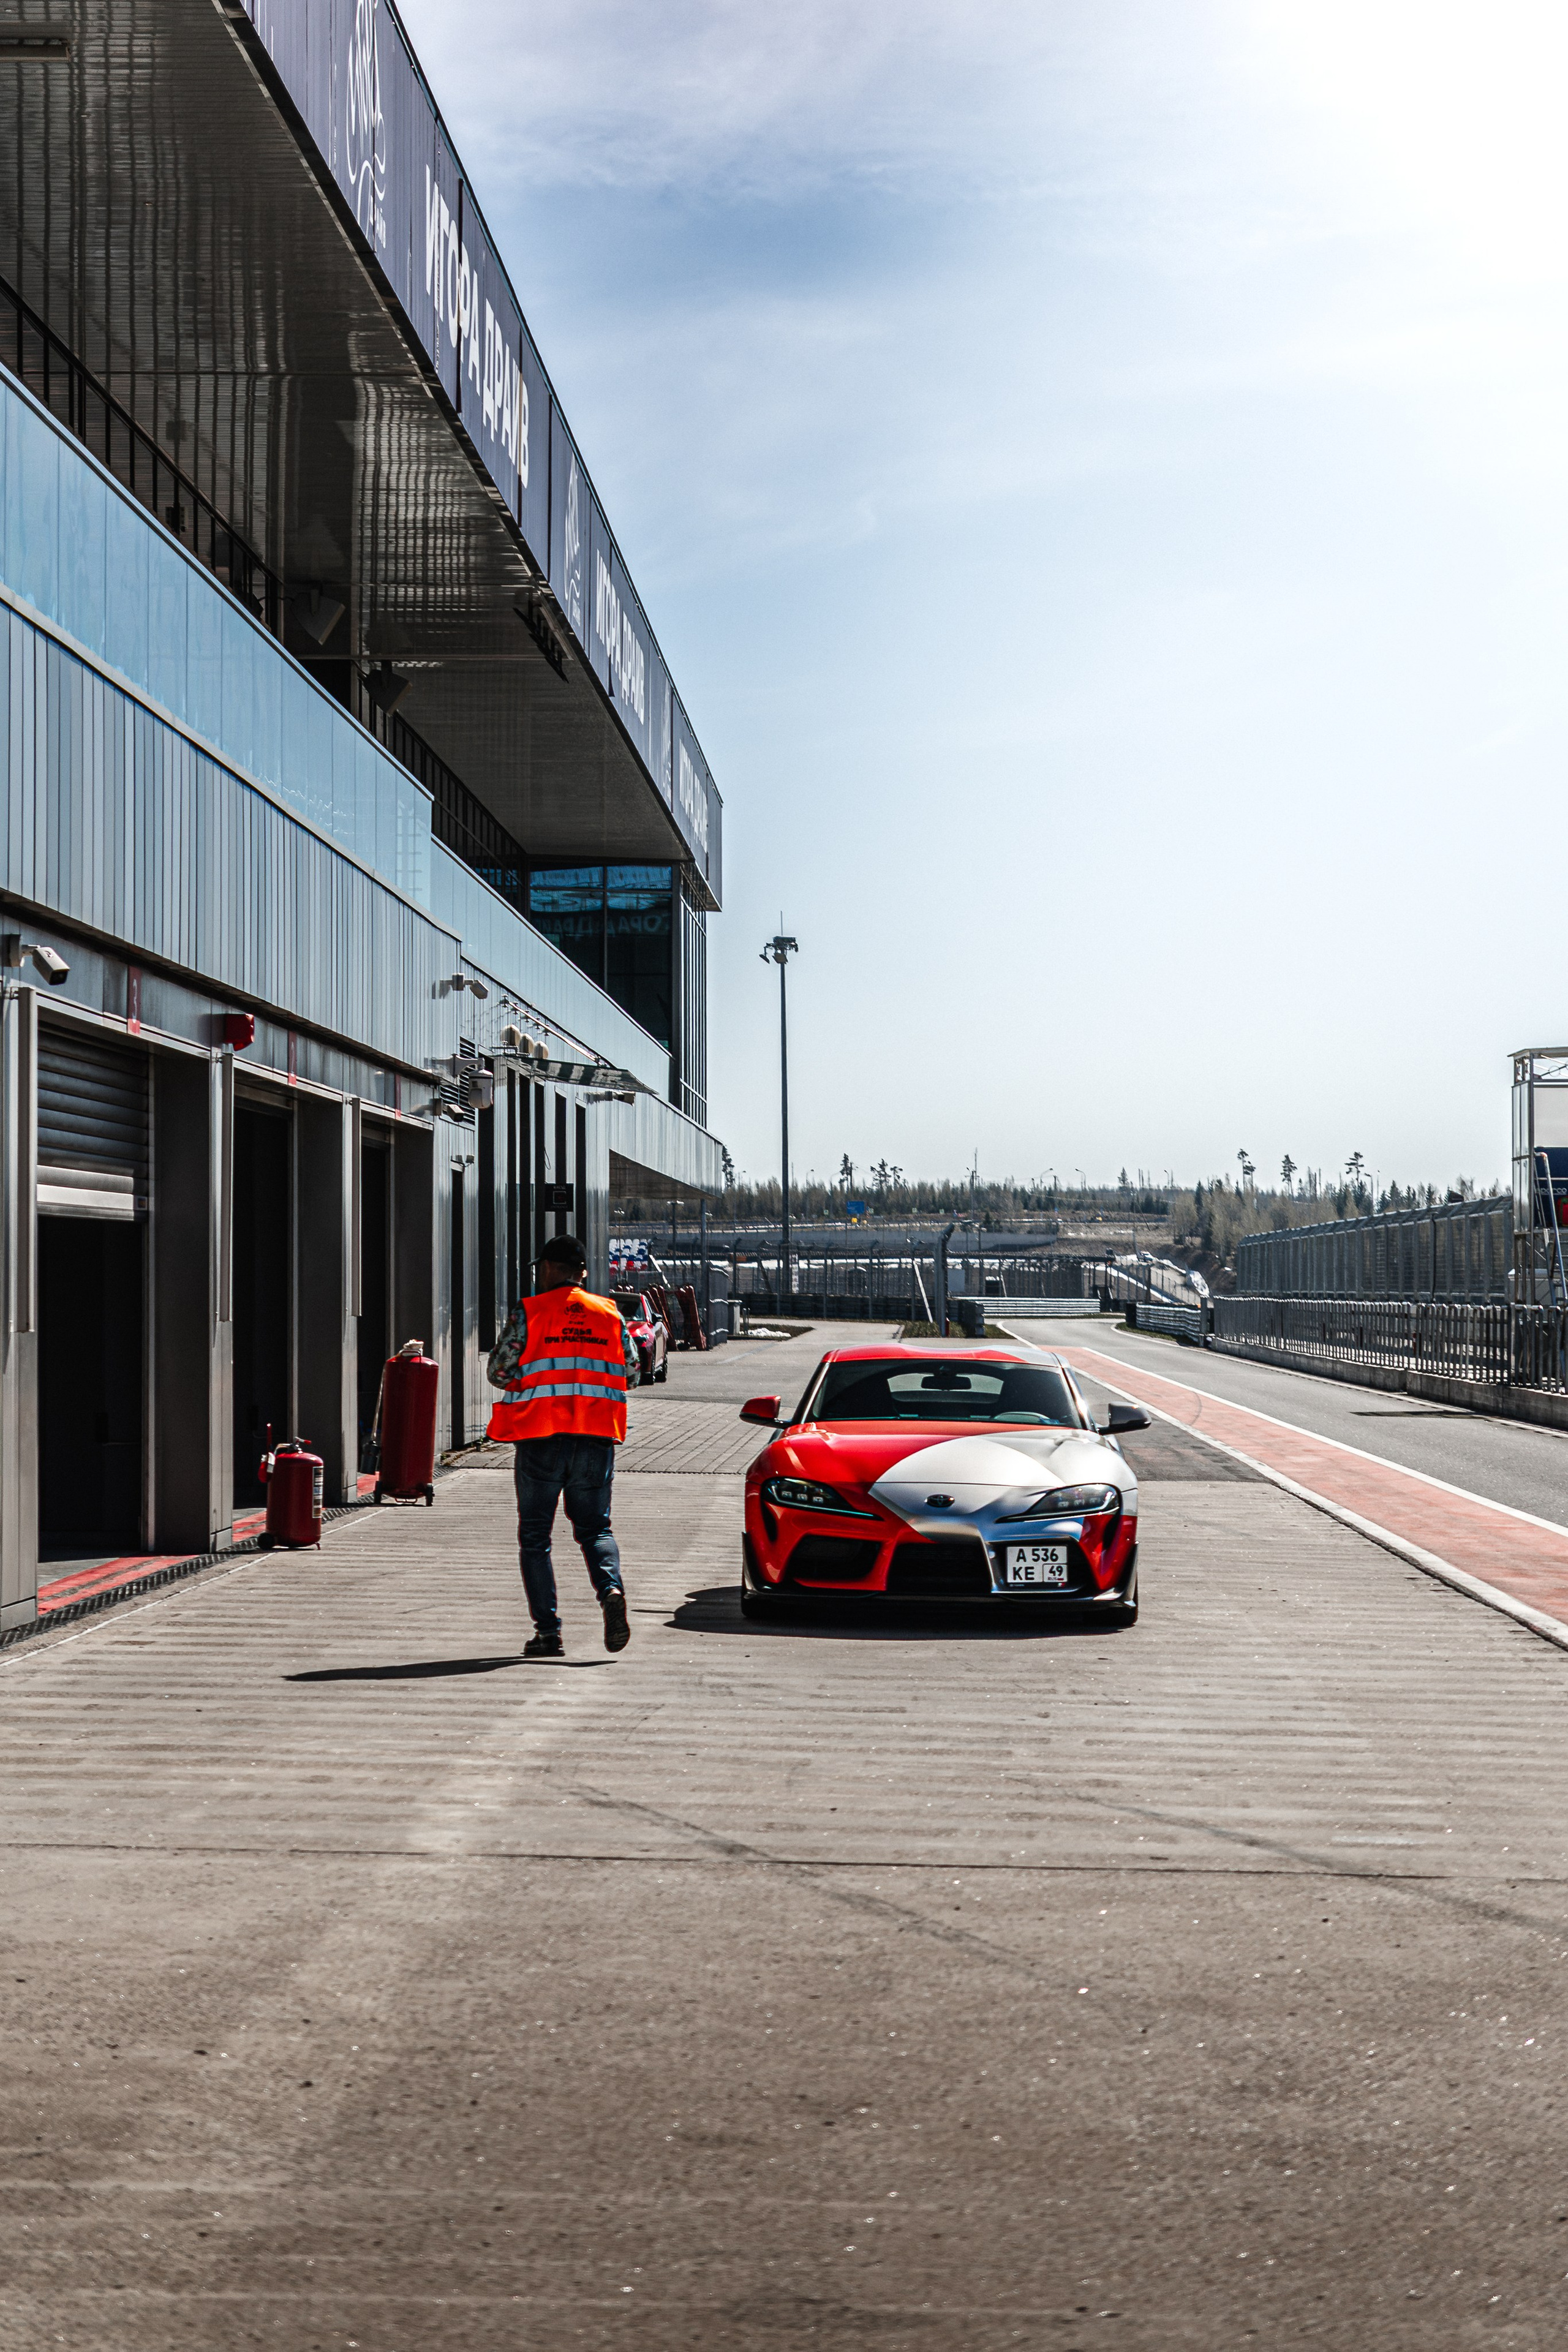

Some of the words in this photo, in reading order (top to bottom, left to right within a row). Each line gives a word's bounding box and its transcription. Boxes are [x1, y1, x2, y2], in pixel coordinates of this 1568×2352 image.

[426, 163, 480, 398] ИГОРА
[596, 548, 621, 681] ИГОРА
[132, 978, 138, 1023] 3
[562, 1327, 592, 1336] СУДЬЯ
[561, 1336, 608, 1346] УЧАСТНИКАХ
[1016, 1548, 1027, 1562] A
[1031, 1548, 1058, 1562] 536
[1012, 1566, 1035, 1581] KE
[1049, 1565, 1063, 1577] 49
